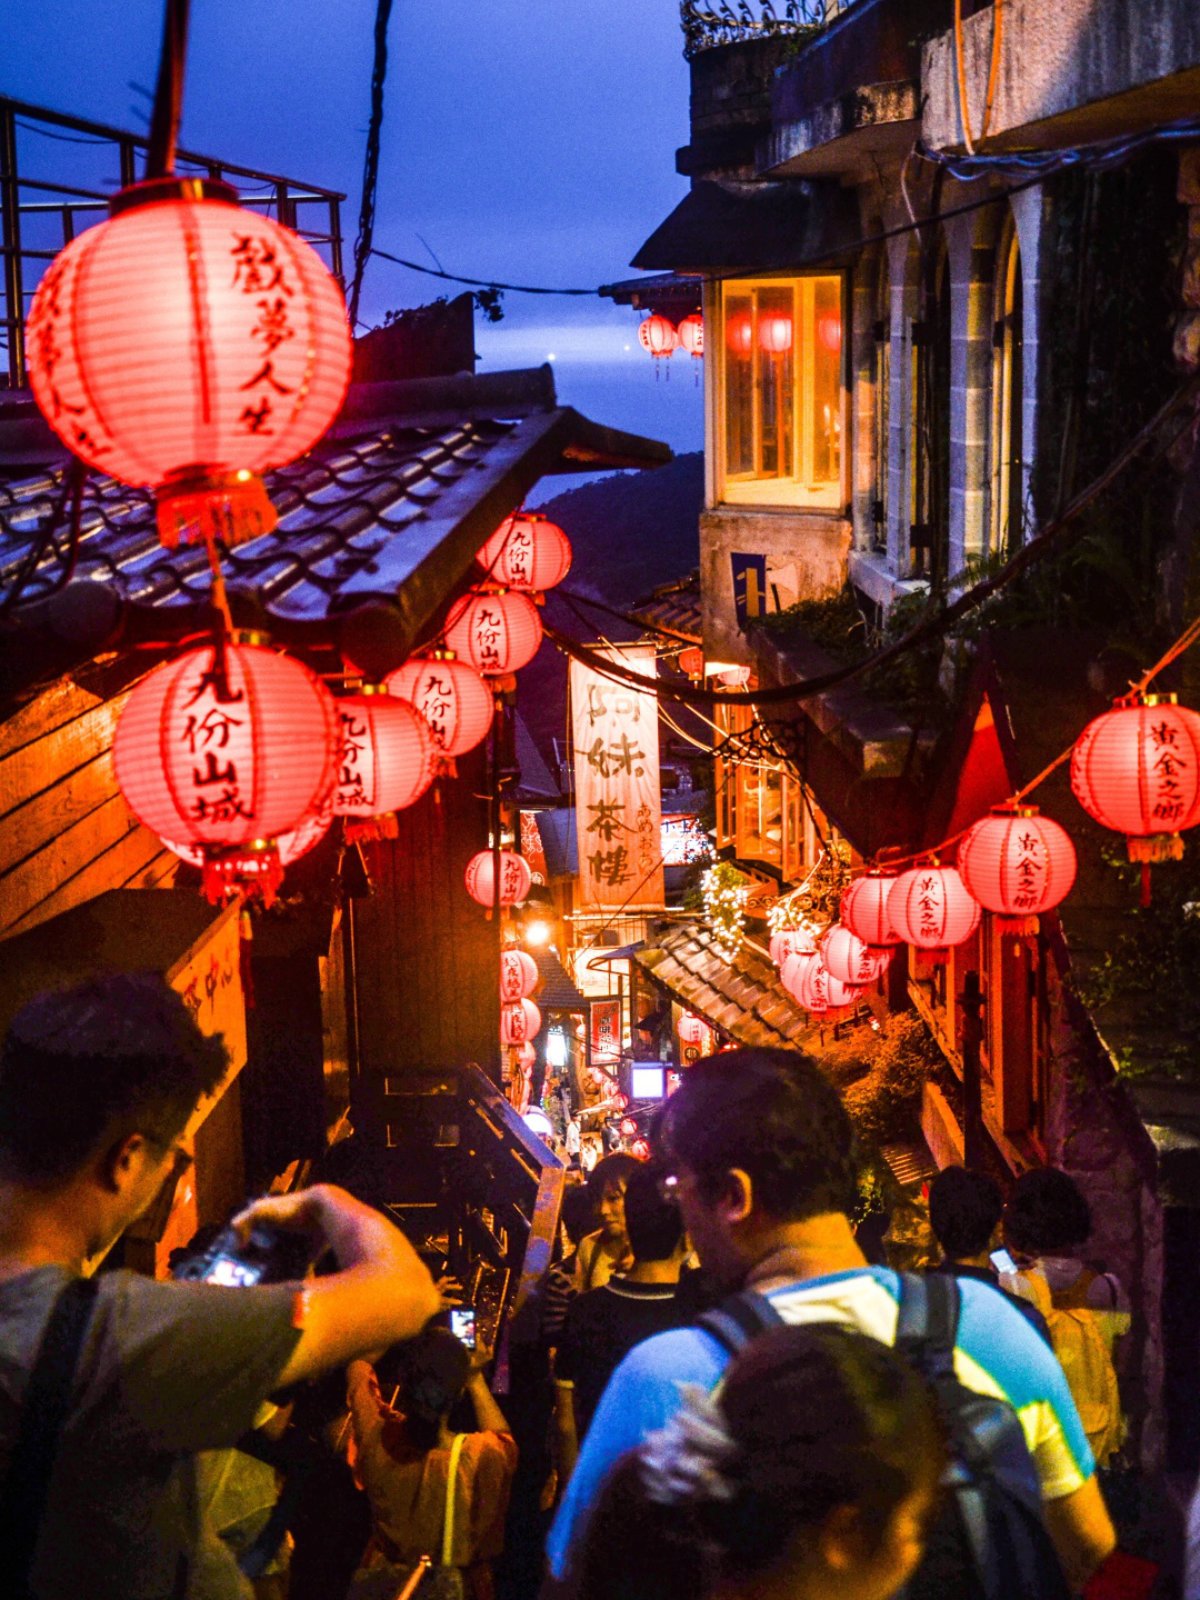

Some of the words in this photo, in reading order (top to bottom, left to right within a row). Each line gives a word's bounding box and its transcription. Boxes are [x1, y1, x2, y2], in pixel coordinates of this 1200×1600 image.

[508, 531, 531, 587] 九份山城
[475, 609, 505, 670] 九份山城
[179, 672, 254, 825] 九份山城
